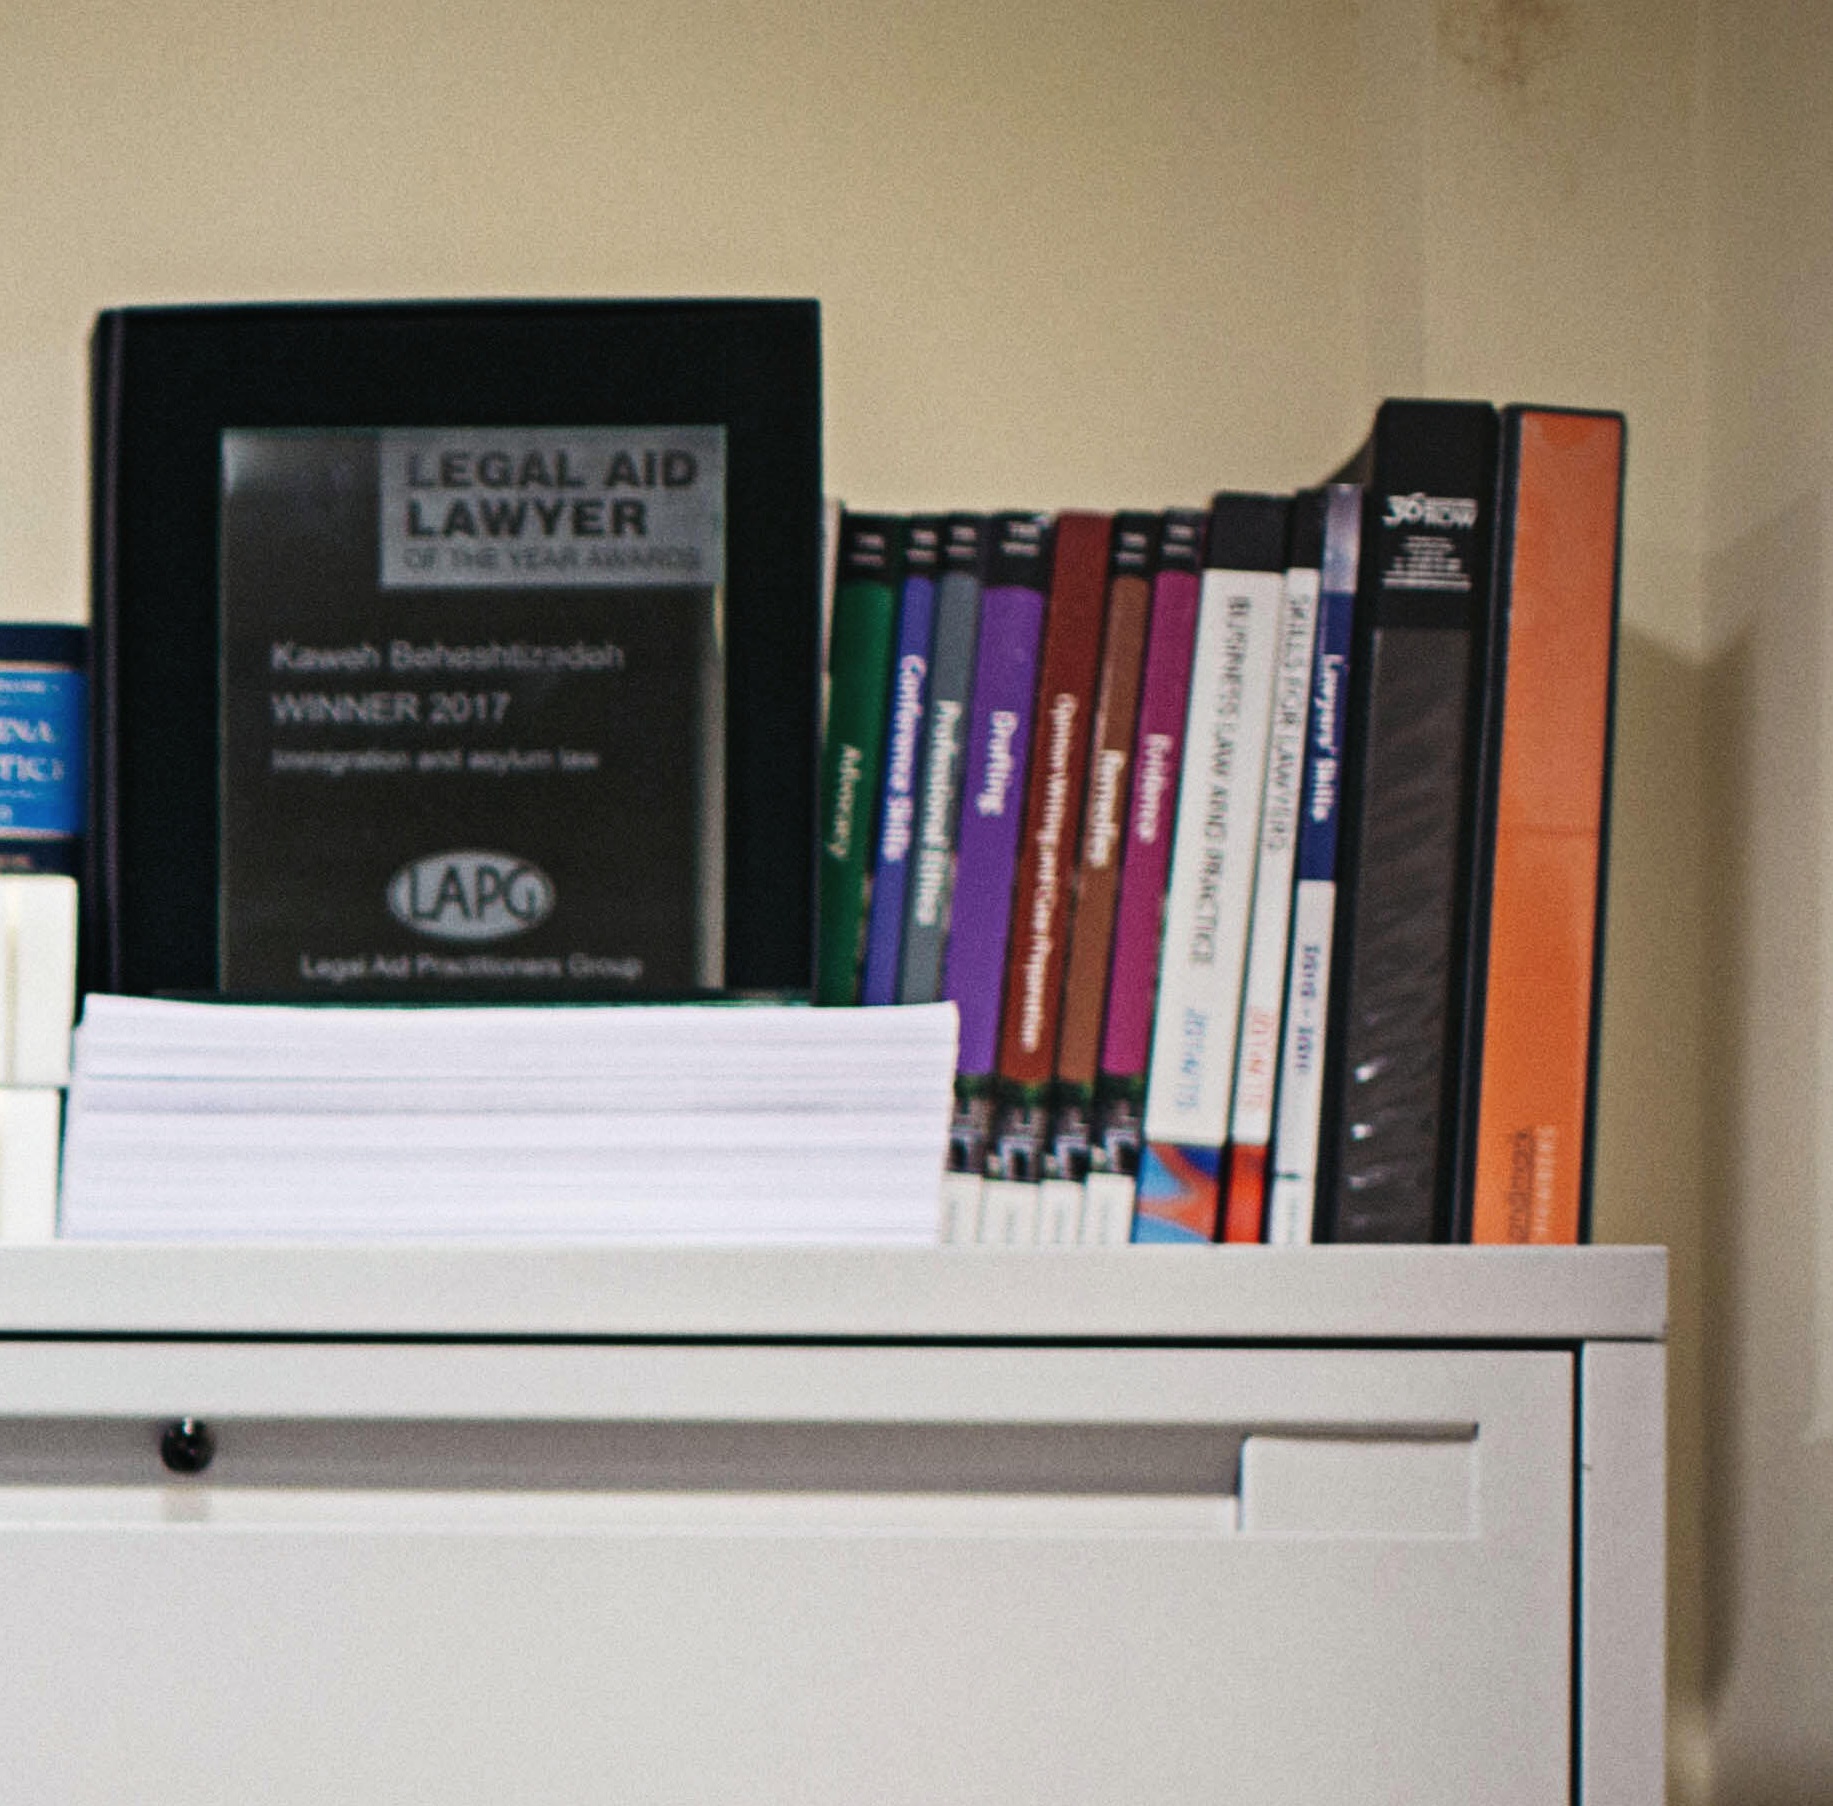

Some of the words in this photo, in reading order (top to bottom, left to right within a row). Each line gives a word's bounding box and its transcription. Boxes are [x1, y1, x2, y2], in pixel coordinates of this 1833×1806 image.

[405, 449, 584, 489] LEGAL
[603, 449, 698, 489] AID
[405, 499, 648, 538] LAWYER
[404, 547, 436, 570] OF
[446, 547, 499, 570] THE
[509, 547, 581, 570] YEAR
[587, 547, 701, 570] AWARDS
[271, 642, 381, 670] Kaweh
[1215, 597, 1251, 719] BUSINESS
[1283, 595, 1310, 671] SKILLS
[271, 693, 421, 724] WINNER
[430, 693, 512, 724] 2017
[888, 655, 925, 791] Conference
[1046, 694, 1077, 771] Opinion
[1278, 679, 1302, 725] FOR
[417, 750, 463, 771] and
[468, 750, 553, 777] asylum
[560, 750, 600, 771] law
[921, 701, 962, 845] Professional
[976, 710, 1019, 815] Drafting
[1137, 734, 1172, 843] Evidence
[1209, 725, 1234, 776] LAW
[1312, 757, 1340, 820] Skills
[828, 744, 863, 859] Advocacy
[882, 795, 910, 860] Skills
[1037, 773, 1067, 845] Writing
[1088, 750, 1126, 868] Remedies
[1203, 782, 1230, 840] AND
[1268, 737, 1298, 853] LAWYERS
[407, 866, 547, 922] LAPG
[915, 849, 945, 926] Ethics
[1192, 848, 1224, 966] PRACTICE
[299, 954, 365, 982] Legal
[372, 954, 409, 978] Aid
[417, 954, 562, 978] Practitioners
[568, 954, 643, 981] Group
[1020, 936, 1052, 1051] Preparation
[1507, 1129, 1536, 1243] andmark
[1534, 1124, 1558, 1238] HAMBERS
